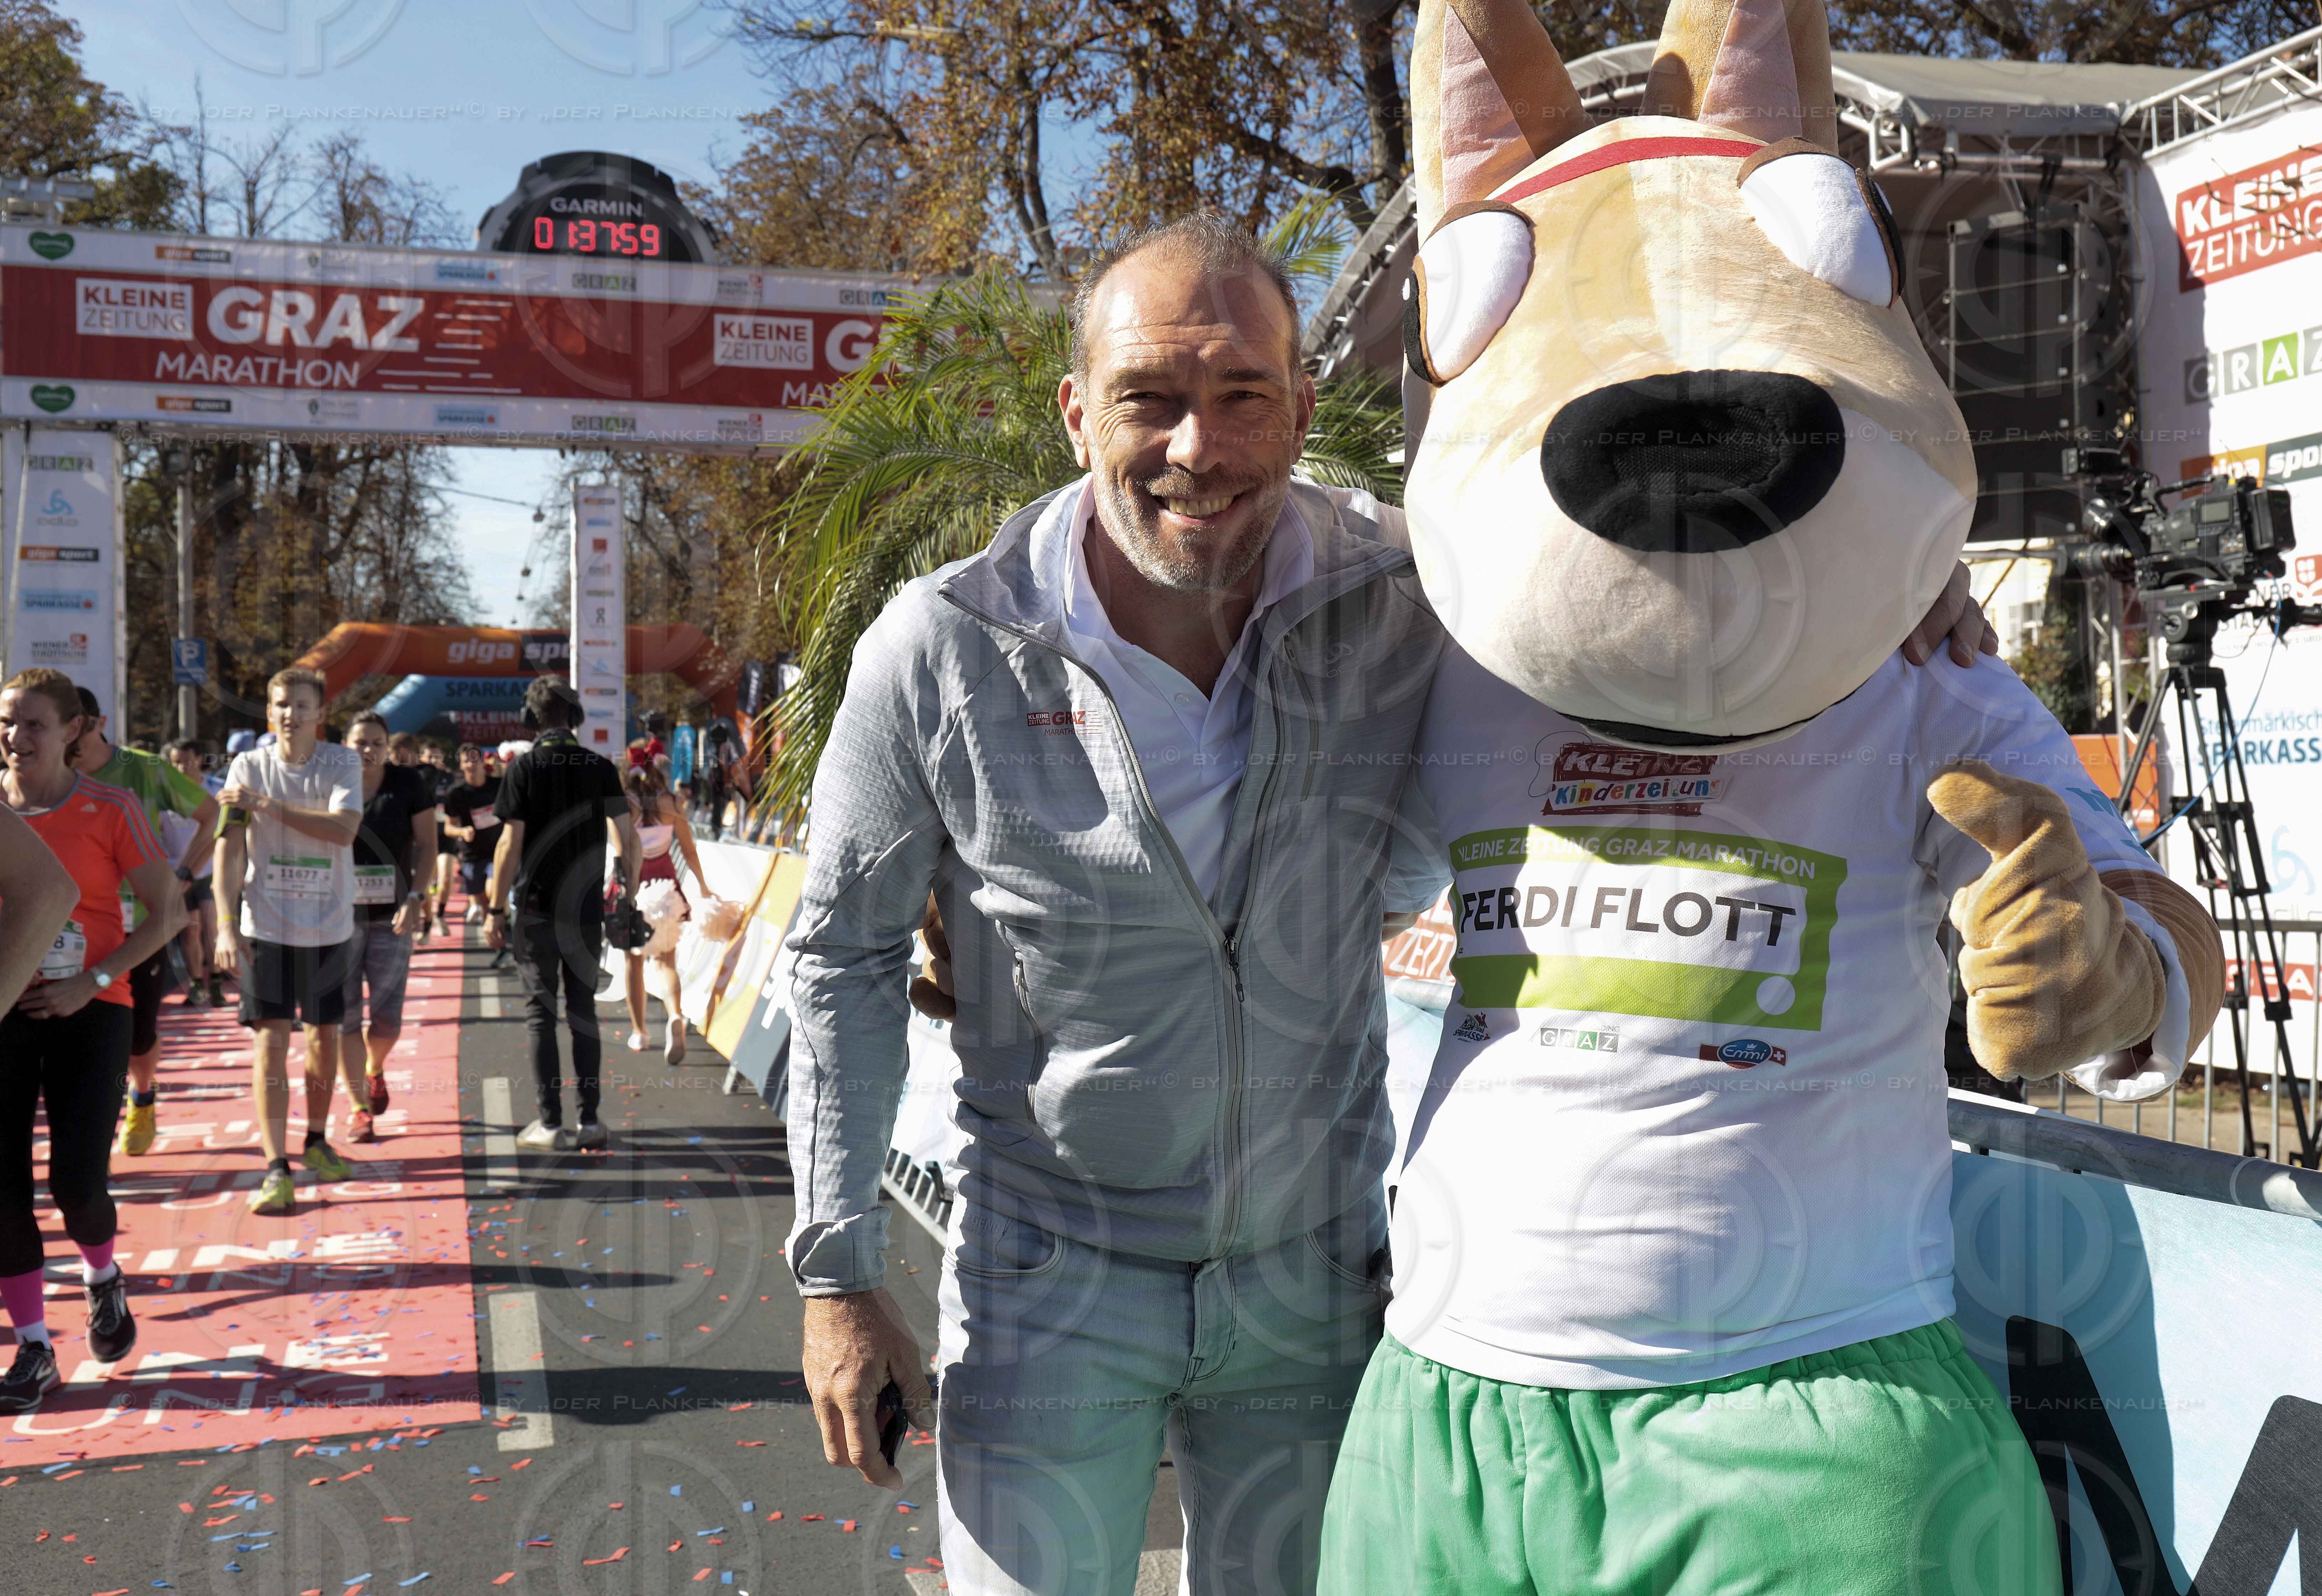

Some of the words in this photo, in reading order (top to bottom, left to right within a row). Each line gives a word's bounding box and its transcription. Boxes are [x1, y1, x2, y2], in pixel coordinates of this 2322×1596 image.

[550, 197, 643, 217] GARMIN
[2182, 154, 2322, 238] KLEINE
[2186, 200, 2322, 277] ZEITUNG
[83, 286, 185, 309] KLEINE
[83, 307, 185, 332] ZEITUNG
[207, 286, 424, 352] GRAZ
[721, 322, 807, 341] KLEINE
[721, 341, 807, 363] ZEITUNG
[155, 352, 360, 388] MARATHON
[2267, 446, 2322, 478] spo
[447, 639, 515, 664] giga
[523, 641, 570, 663] spo
[1052, 711, 1086, 725] GRAZ
[1563, 751, 1702, 776] KLEINE
[1606, 838, 1671, 856] GRAZ
[1676, 841, 1815, 879] MARATHON
[1461, 886, 1578, 933] FERDI
[1590, 887, 1796, 947] FLOTT
[1722, 1045, 1767, 1060] Emmi
